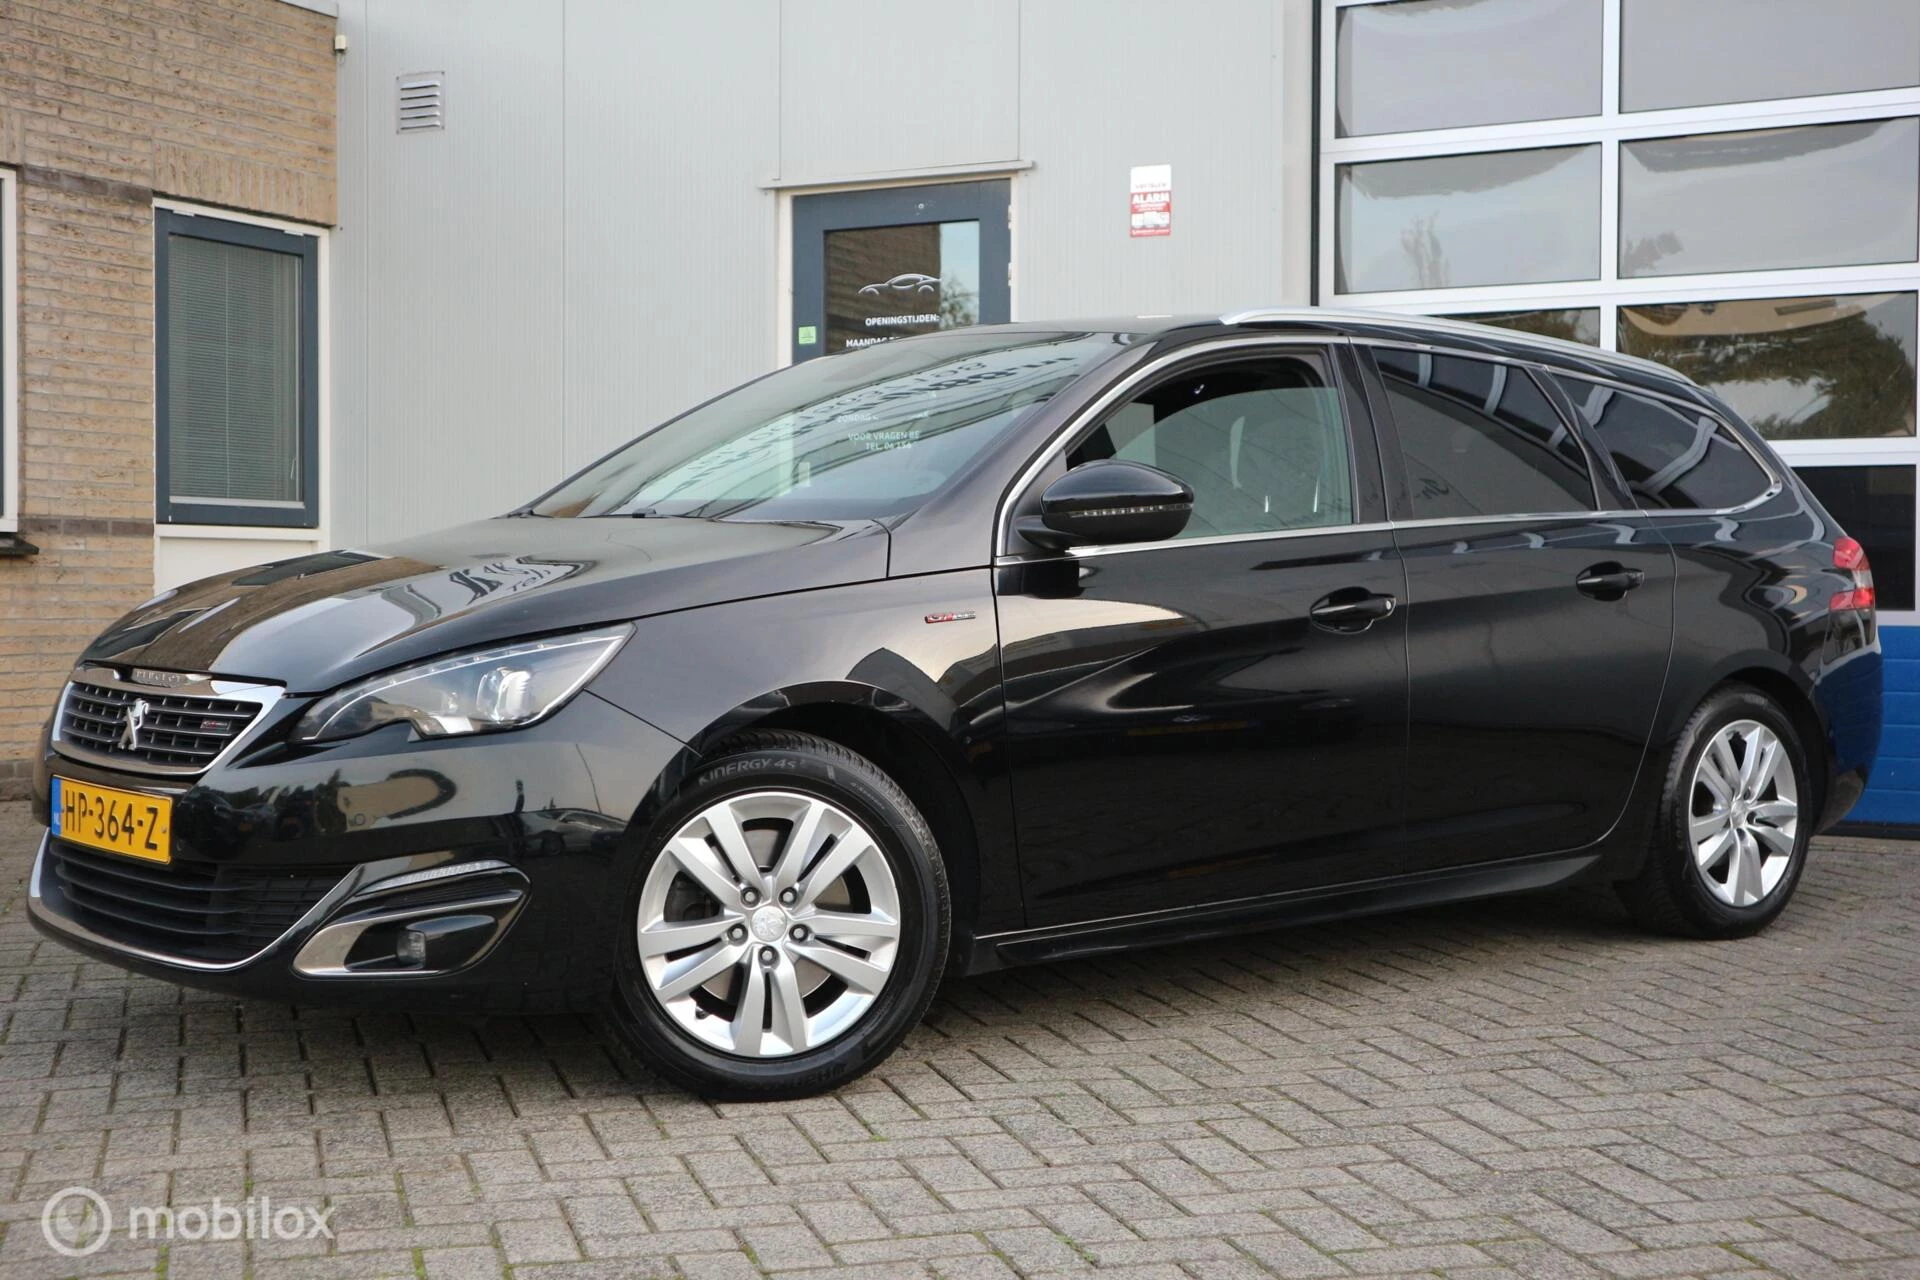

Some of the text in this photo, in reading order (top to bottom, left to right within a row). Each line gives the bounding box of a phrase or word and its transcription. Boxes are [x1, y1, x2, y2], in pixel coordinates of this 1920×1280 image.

[1132, 191, 1170, 204] ALARM
[865, 313, 940, 327] OPENINGSTIJDEN:
[848, 433, 871, 441] VOOR
[872, 432, 907, 441] VRAGEN
[65, 789, 158, 851] HP-364-Z
